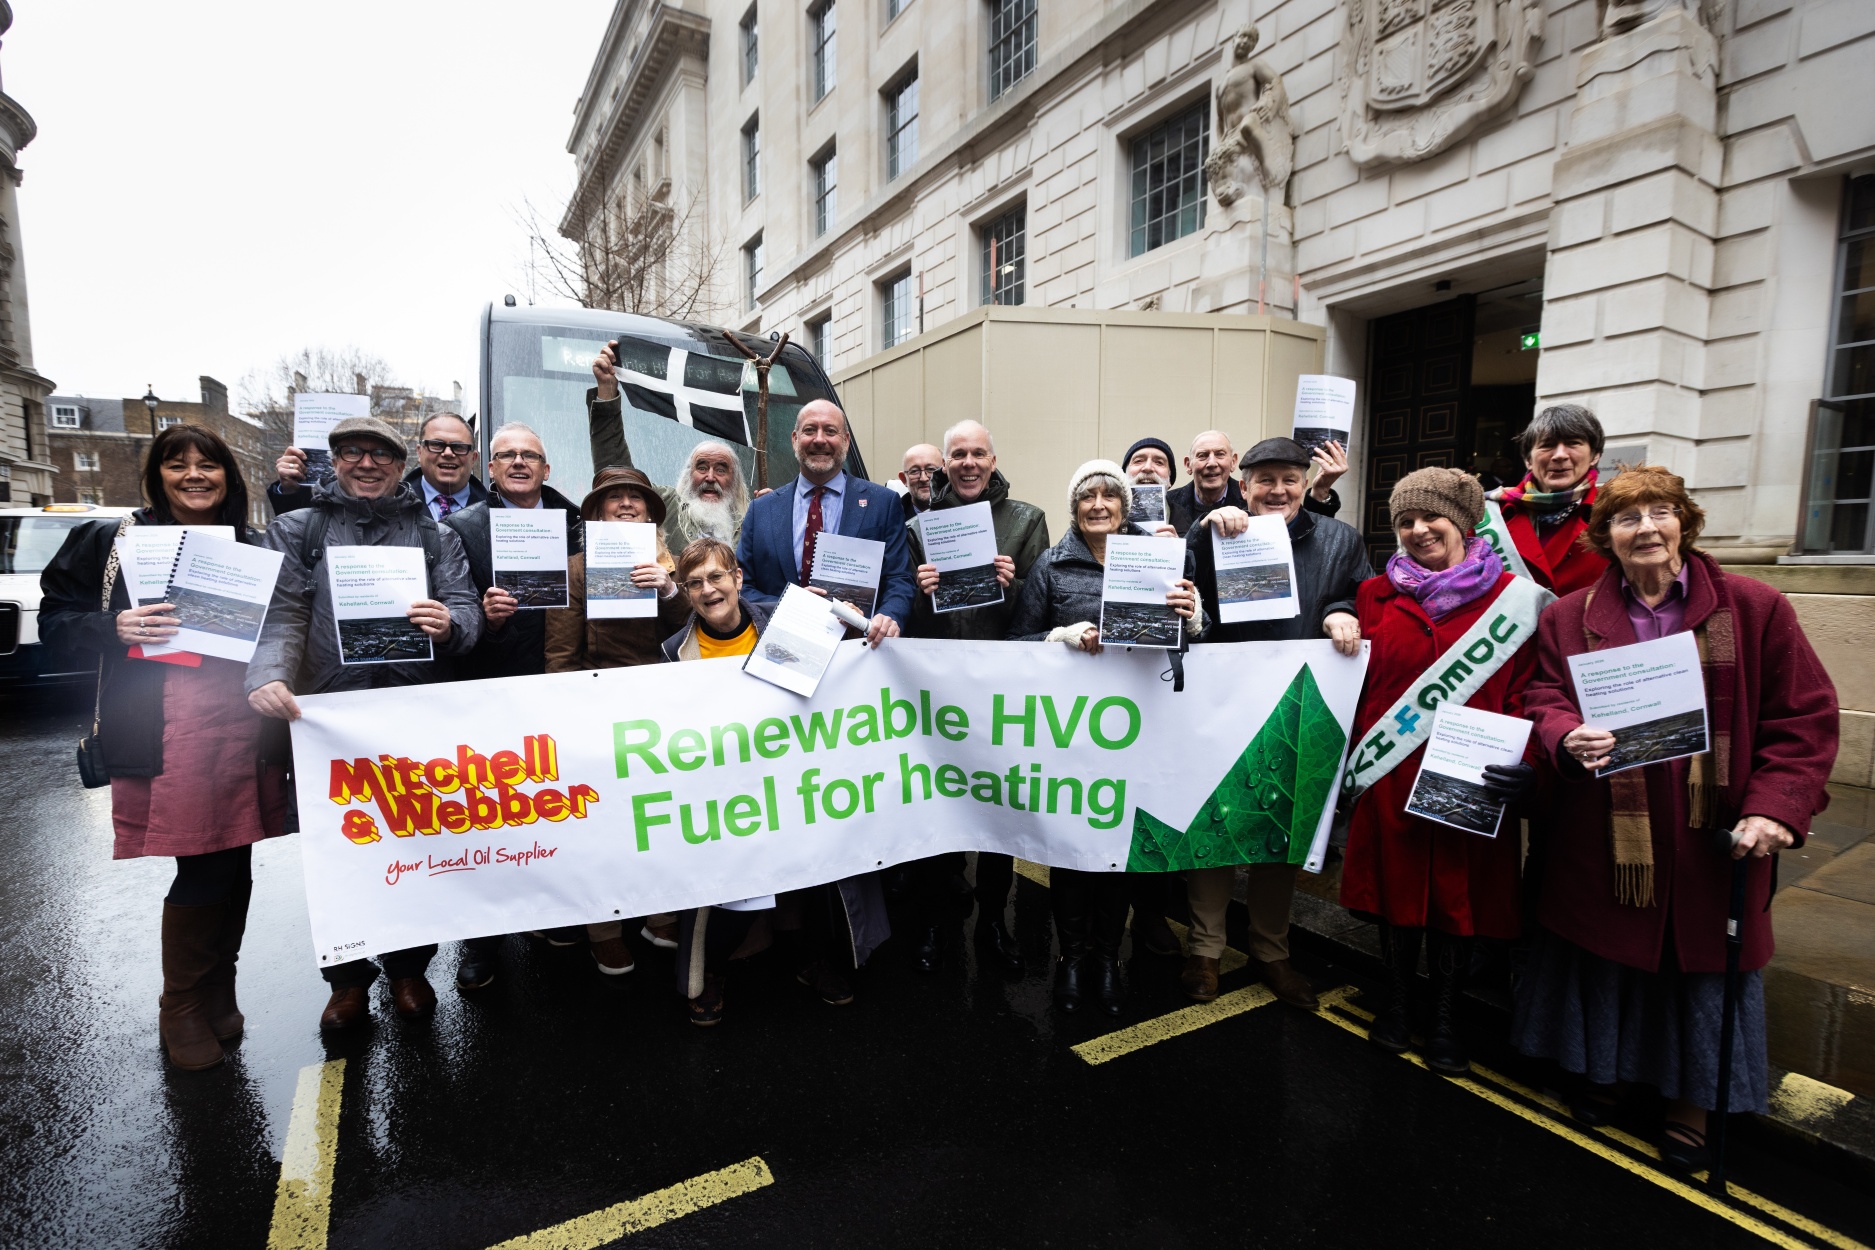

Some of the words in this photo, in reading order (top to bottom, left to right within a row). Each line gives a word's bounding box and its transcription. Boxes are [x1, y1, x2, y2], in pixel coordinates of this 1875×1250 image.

[1417, 613, 1518, 710] UDEG
[1582, 671, 1627, 684] Government
[1628, 663, 1676, 676] consultation:
[1588, 667, 1621, 676] response
[1584, 683, 1611, 692] Exploring
[1643, 672, 1672, 681] alternative
[1394, 704, 1421, 736] 4
[1631, 700, 1662, 712] Cornwall
[612, 687, 970, 779] Renewable
[992, 694, 1142, 750] HVO
[1438, 724, 1470, 735] Government
[1445, 720, 1468, 728] response
[328, 734, 560, 805] Mitchell
[1342, 730, 1396, 794] HVO
[341, 808, 382, 845] &
[372, 783, 600, 838] Webber
[632, 776, 780, 852] Fuel
[796, 768, 885, 825] for
[898, 752, 1126, 830] heating
[428, 848, 468, 870] Local
[473, 846, 490, 866] Oil
[496, 841, 558, 866] Supplier
[345, 940, 365, 949] SIGNS
